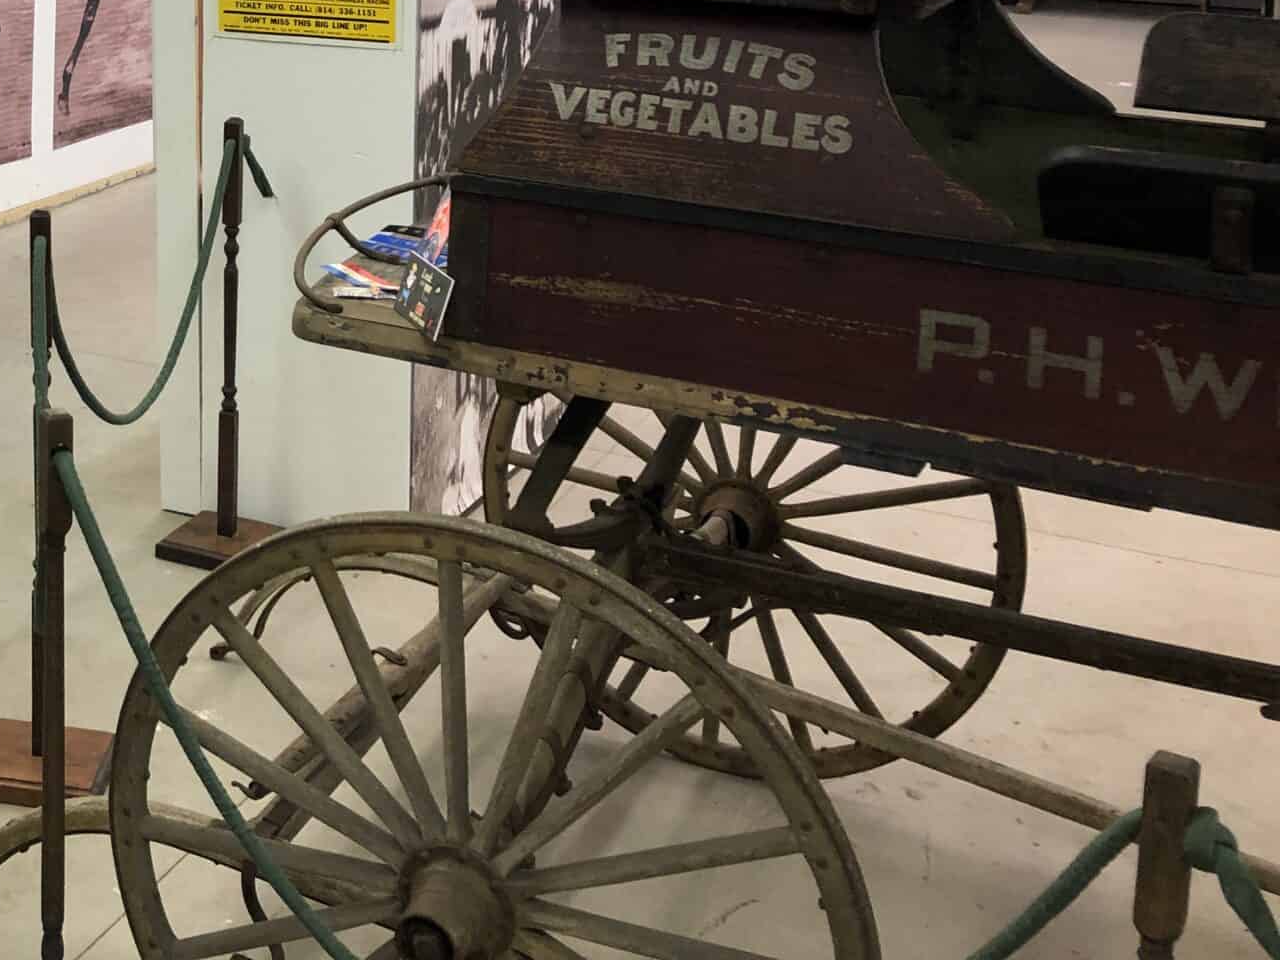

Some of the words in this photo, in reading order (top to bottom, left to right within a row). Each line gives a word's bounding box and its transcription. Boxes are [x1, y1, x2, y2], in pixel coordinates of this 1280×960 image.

[235, 1, 262, 9] TICKET
[243, 16, 267, 25] DON'T
[270, 17, 290, 26] MISS
[293, 18, 312, 27] THIS
[315, 19, 329, 28] BIG
[332, 20, 349, 29] LINE
[353, 22, 368, 31] UP!
[604, 33, 817, 90] FRUITS
[662, 76, 719, 97] AND
[548, 80, 853, 154] VEGETABLES
